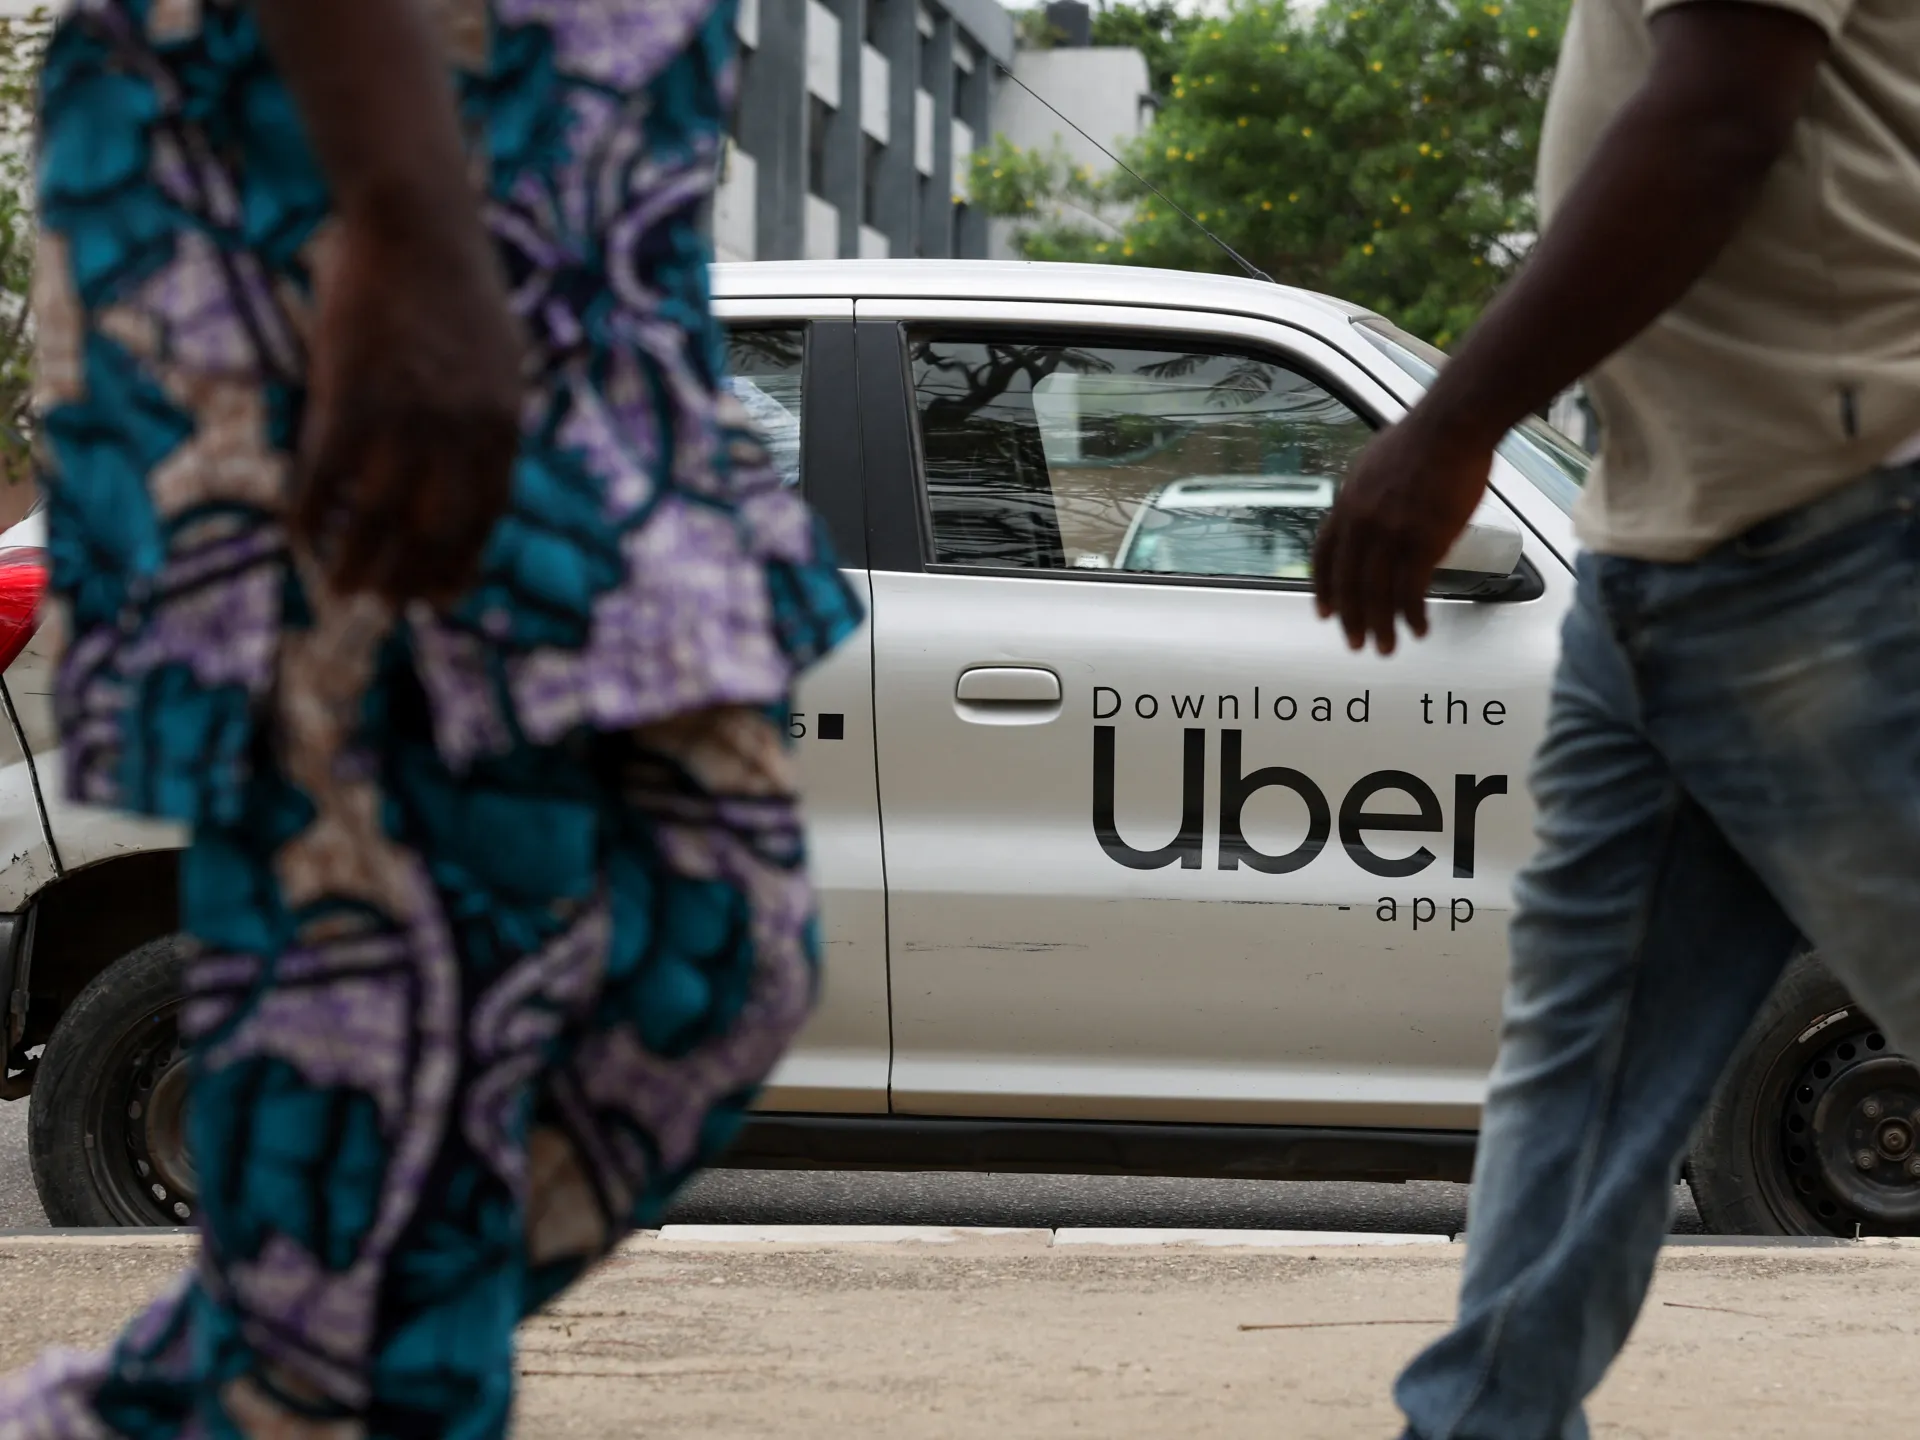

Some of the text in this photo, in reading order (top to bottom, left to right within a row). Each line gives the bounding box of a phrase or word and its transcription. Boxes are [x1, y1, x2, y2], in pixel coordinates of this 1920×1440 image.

[1092, 686, 1508, 726] Download the
[1092, 725, 1508, 879] Uber
